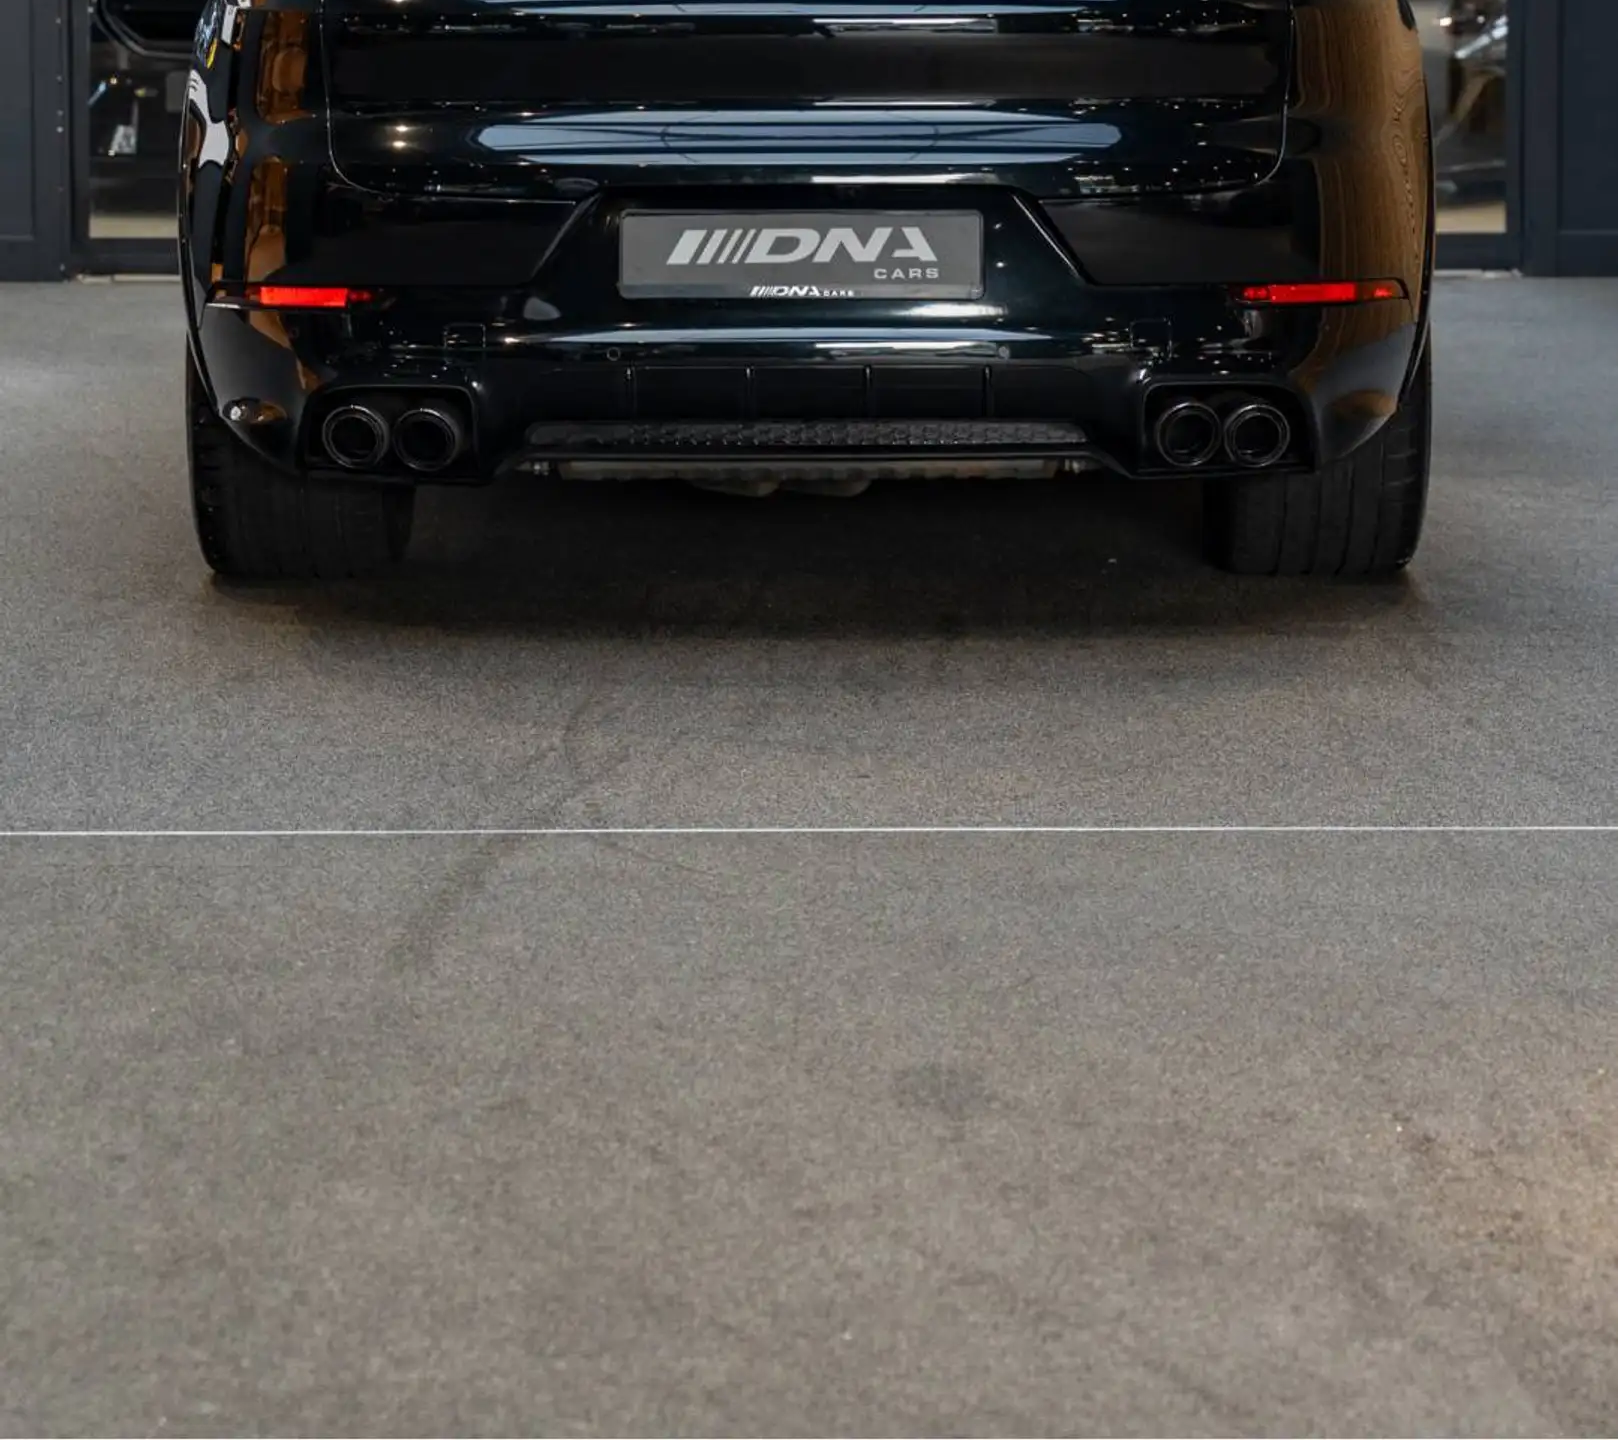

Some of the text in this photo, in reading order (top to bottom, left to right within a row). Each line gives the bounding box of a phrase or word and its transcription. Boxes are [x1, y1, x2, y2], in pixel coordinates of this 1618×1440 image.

[745, 227, 938, 264] DNA
[873, 268, 940, 280] CARS
[772, 285, 820, 297] DNA
